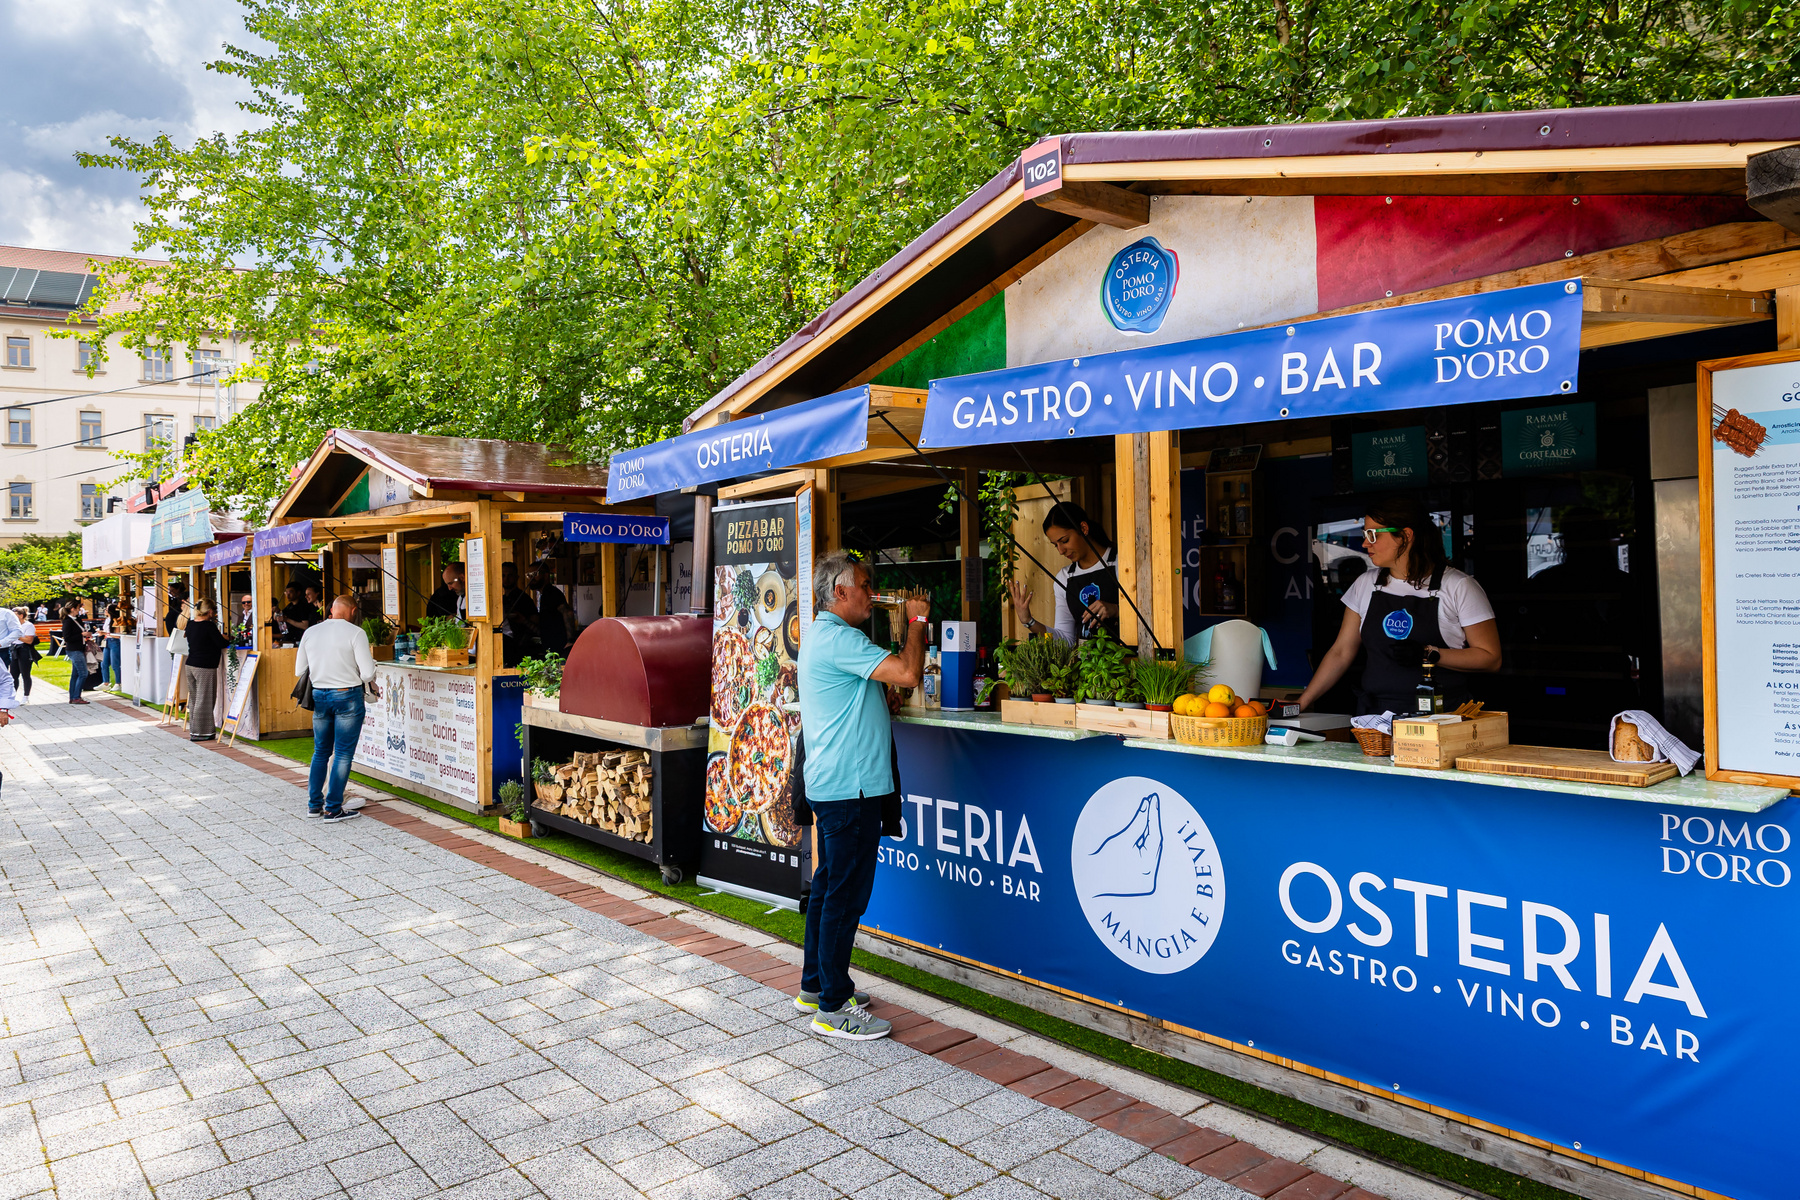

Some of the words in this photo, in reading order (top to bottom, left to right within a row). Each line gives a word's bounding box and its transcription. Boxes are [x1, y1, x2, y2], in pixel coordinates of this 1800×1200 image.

[1027, 159, 1056, 183] 102
[1116, 252, 1159, 279] OSTERIA
[1123, 272, 1154, 289] POMO
[1115, 298, 1132, 318] GASTRO
[1137, 306, 1152, 317] VINO
[1155, 287, 1164, 302] BAR
[1123, 284, 1154, 301] D'ORO
[1434, 309, 1552, 351] POMO
[1434, 345, 1550, 384] D'ORO
[952, 381, 1092, 429] GASTRO
[1124, 362, 1238, 411] VINO
[1281, 342, 1382, 395] BAR
[1526, 411, 1568, 424] RARAMÈ
[697, 427, 773, 469] OSTERIA
[1372, 434, 1406, 445] RARAMÈ
[1520, 448, 1576, 460] CORTEAURA
[619, 457, 644, 476] POMO
[1367, 467, 1413, 477] CORTEAURA
[618, 473, 645, 491] D'ORO
[571, 522, 613, 535] POMO
[728, 518, 784, 540] PIZZABAR
[727, 538, 753, 555] POMO
[757, 536, 784, 552] D'ORO
[408, 674, 435, 694] Trattoria
[448, 680, 474, 696] originalità
[409, 702, 424, 722] Vino
[456, 696, 474, 709] fantasia
[432, 722, 457, 742] cucina
[410, 745, 438, 766] tradizione
[439, 763, 475, 784] gastronomia
[888, 794, 1043, 873] TERIA
[1660, 813, 1791, 853] POMO
[1178, 820, 1214, 899] BEVI!
[1660, 846, 1791, 888] D'ORO
[877, 846, 919, 871] STRO
[936, 859, 982, 887] VINO
[1003, 875, 1040, 902] BAR
[1191, 907, 1210, 927] E
[1101, 910, 1198, 958] MANGIA
[1278, 861, 1708, 1018] OSTERIA
[1282, 940, 1417, 993] GASTRO
[1457, 978, 1561, 1028] VINO
[1610, 1014, 1700, 1062] BAR
